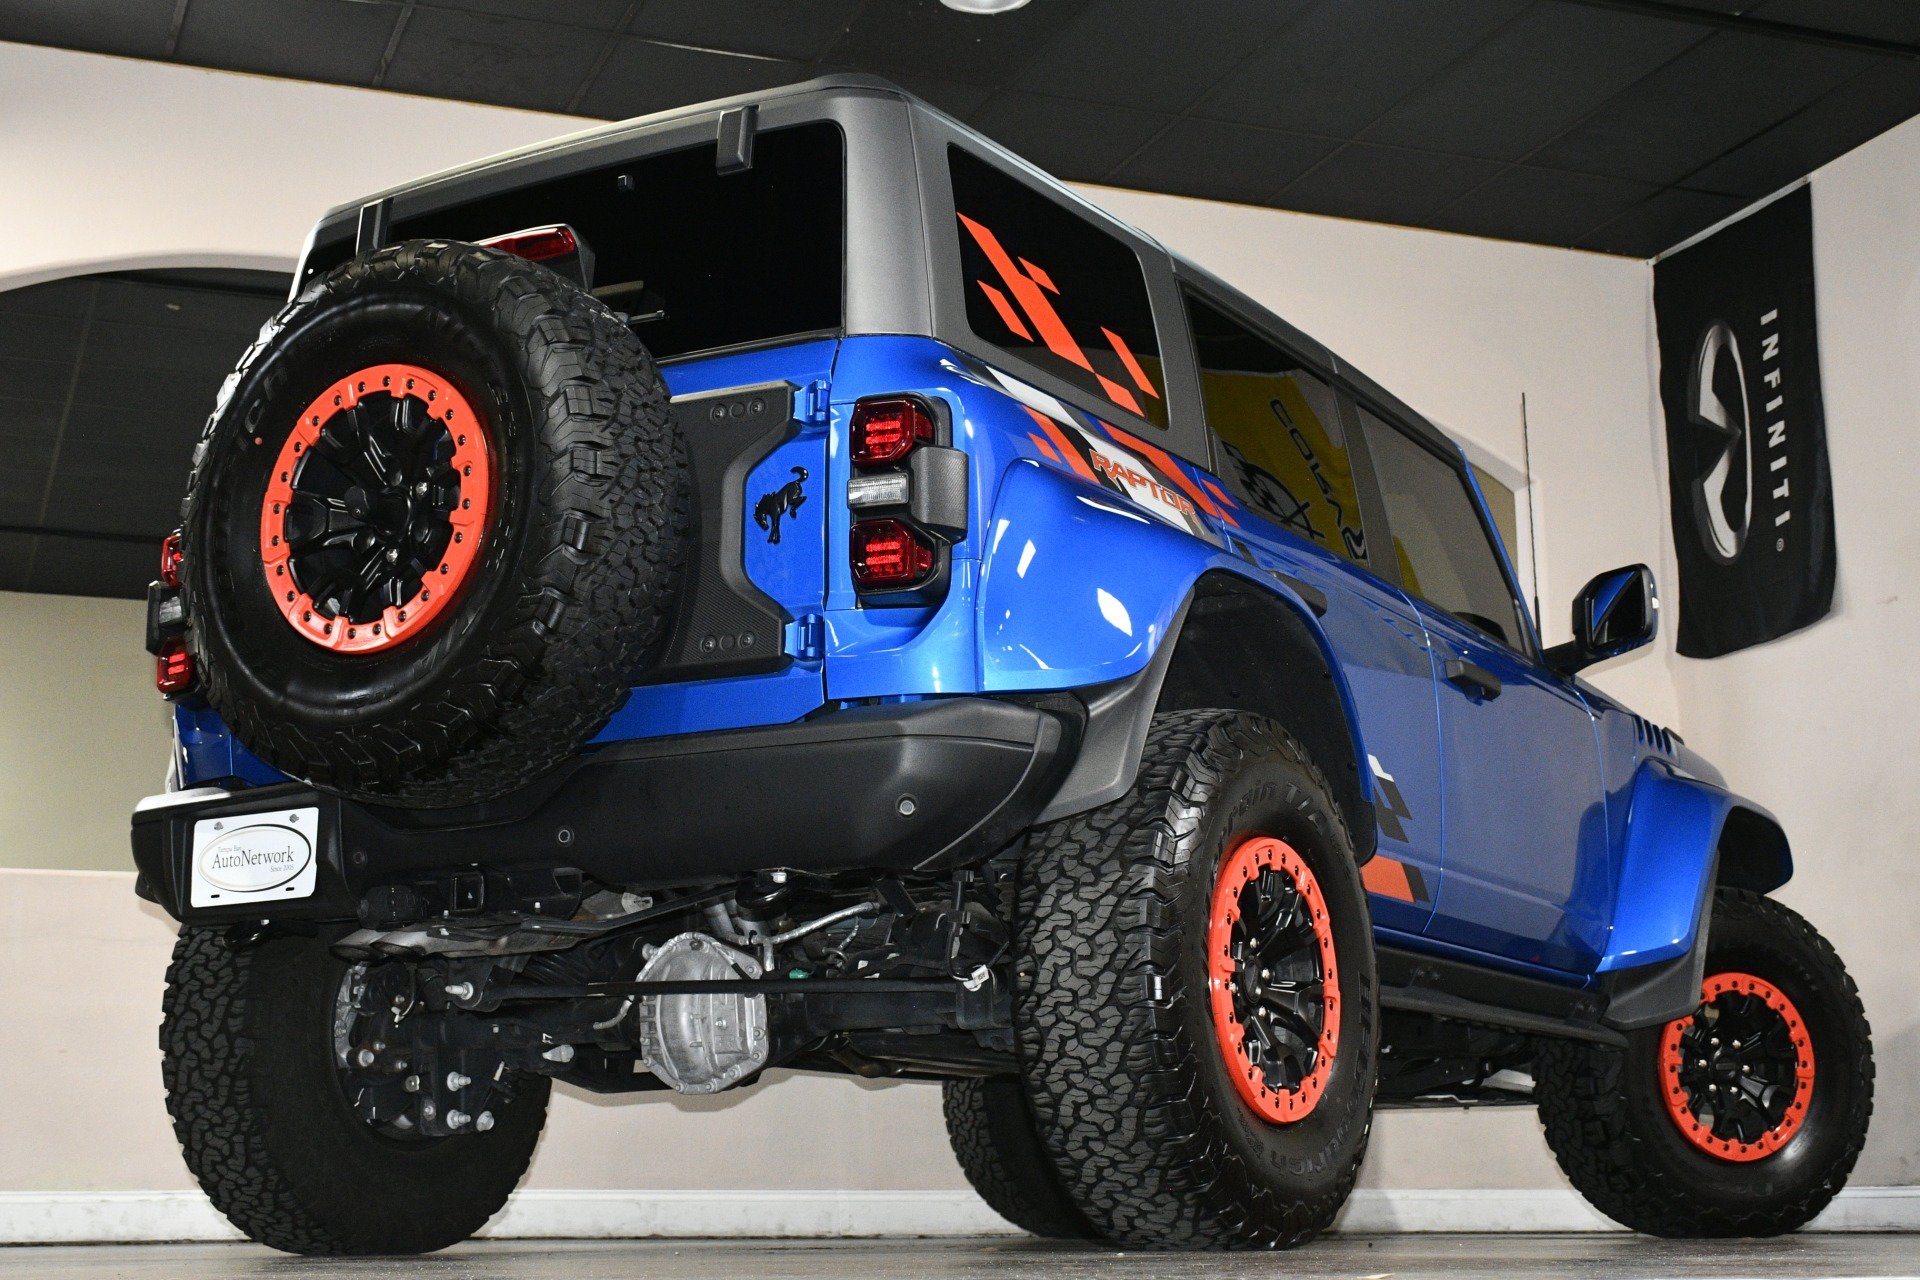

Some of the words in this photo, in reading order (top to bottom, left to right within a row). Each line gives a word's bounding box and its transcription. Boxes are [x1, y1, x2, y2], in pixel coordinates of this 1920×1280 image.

[1760, 308, 1791, 527] INFINITI
[1089, 448, 1204, 535] RAPTOR
[212, 845, 294, 869] AutoNetwork
